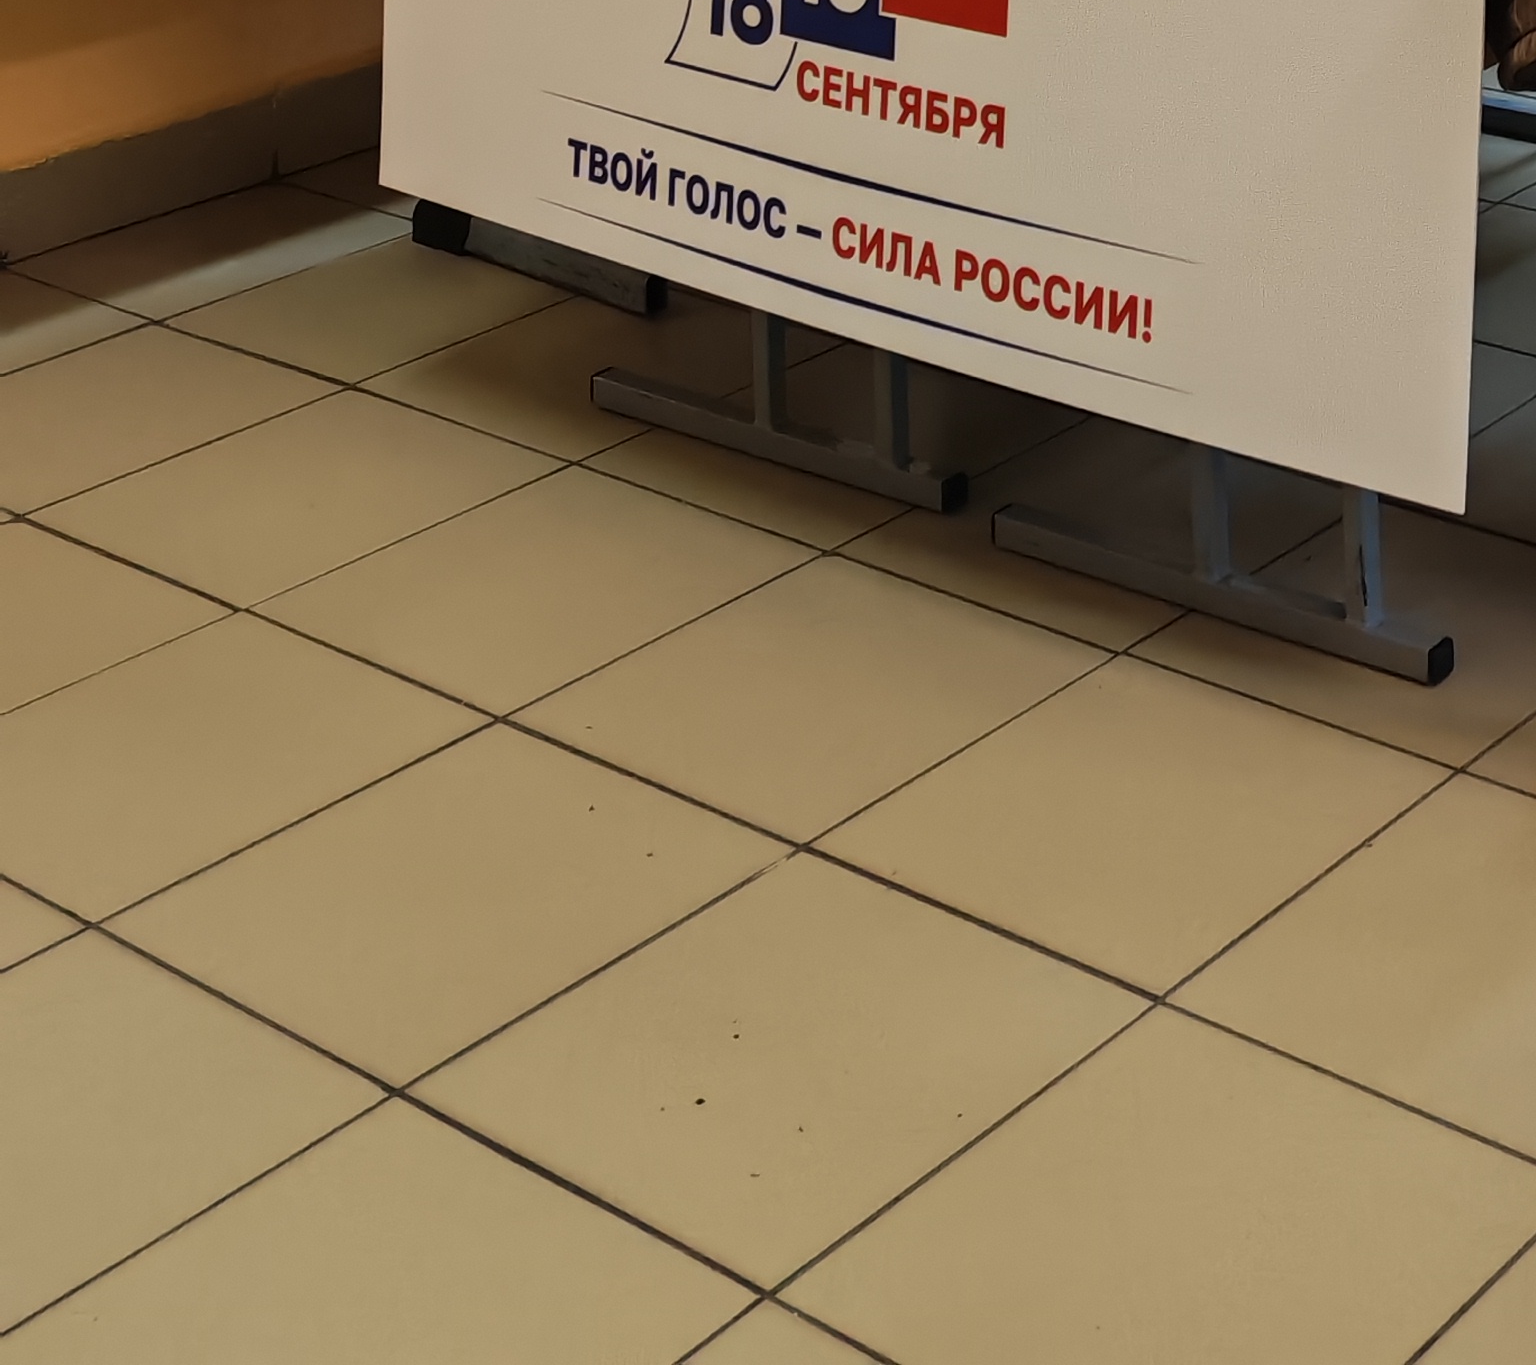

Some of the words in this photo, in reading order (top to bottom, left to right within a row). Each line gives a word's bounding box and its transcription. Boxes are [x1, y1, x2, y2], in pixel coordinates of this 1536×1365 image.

[796, 60, 1006, 149] СЕНТЯБРЯ
[567, 137, 658, 201] ТВОЙ
[667, 167, 787, 240] ГОЛОС
[832, 216, 942, 287] СИЛА
[953, 251, 1154, 344] РОССИИ!
